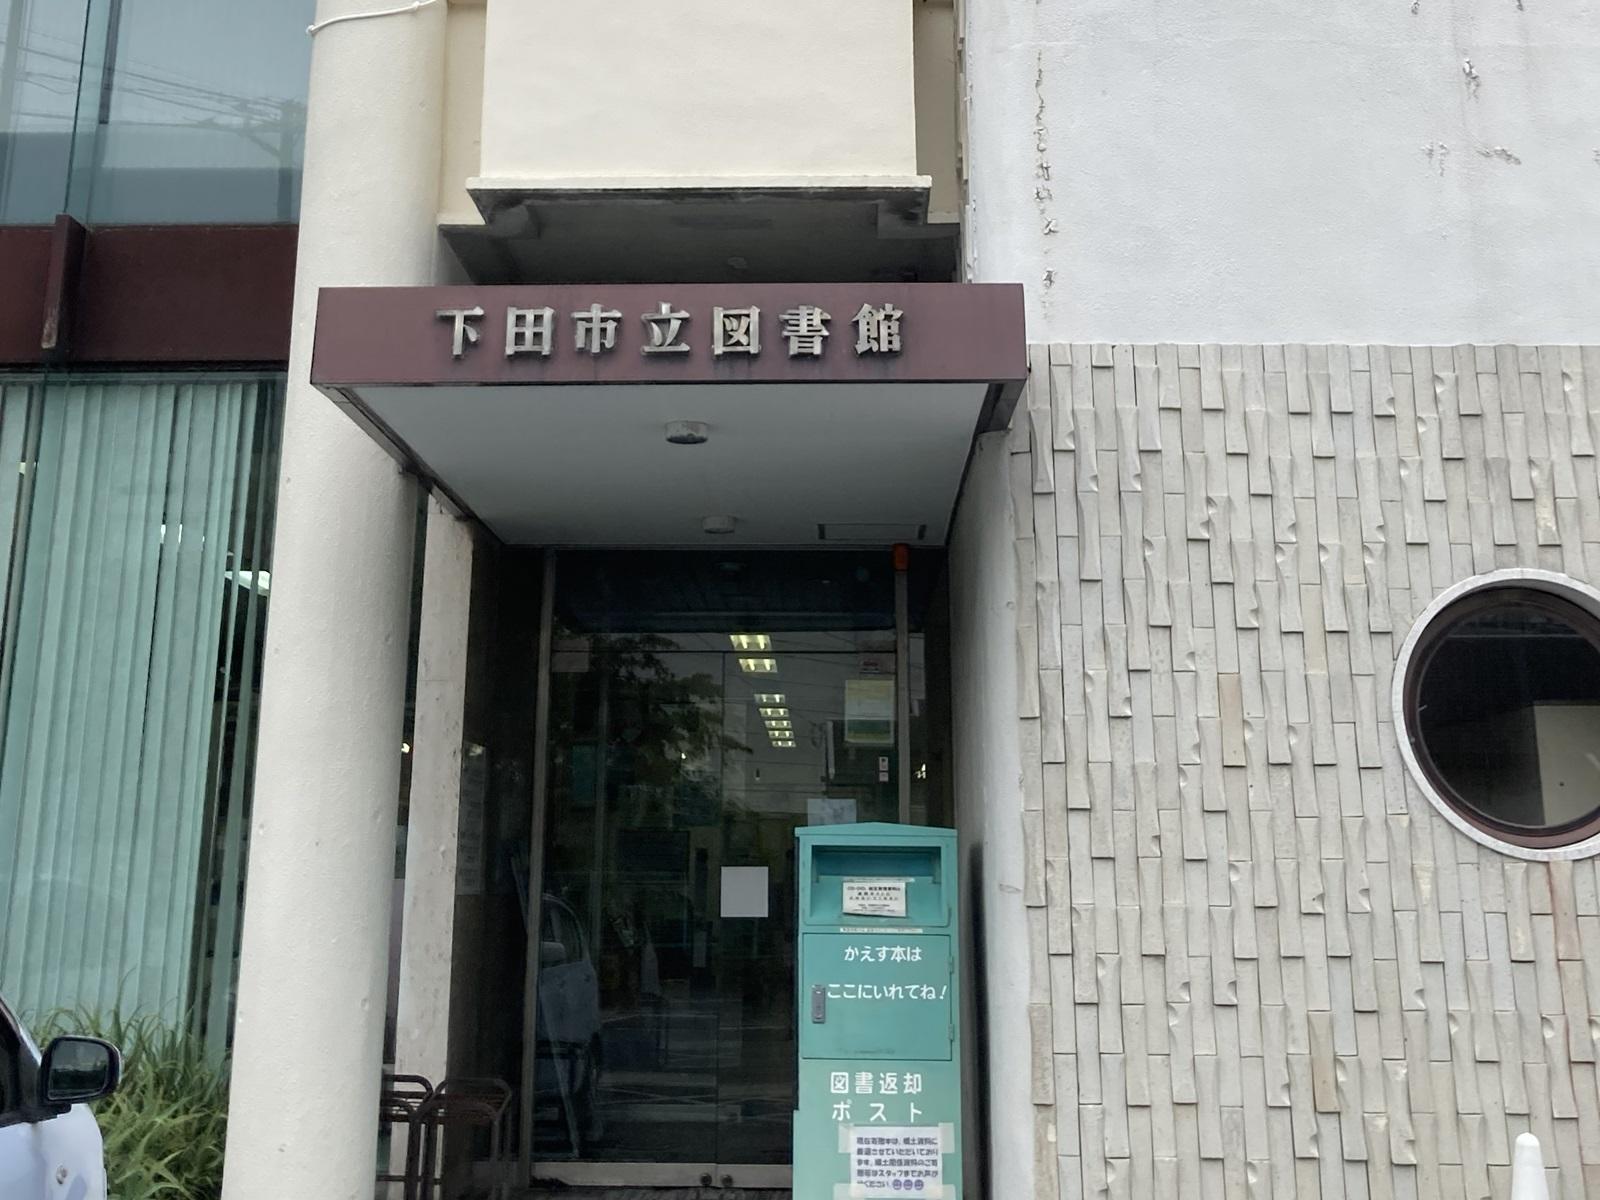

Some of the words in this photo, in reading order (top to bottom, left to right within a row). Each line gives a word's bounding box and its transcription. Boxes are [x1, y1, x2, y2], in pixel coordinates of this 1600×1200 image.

[435, 301, 904, 357] 下田市立図書館
[843, 945, 922, 963] かえす本は
[830, 1071, 923, 1095] 図書返却
[831, 1099, 923, 1123] ポスト
